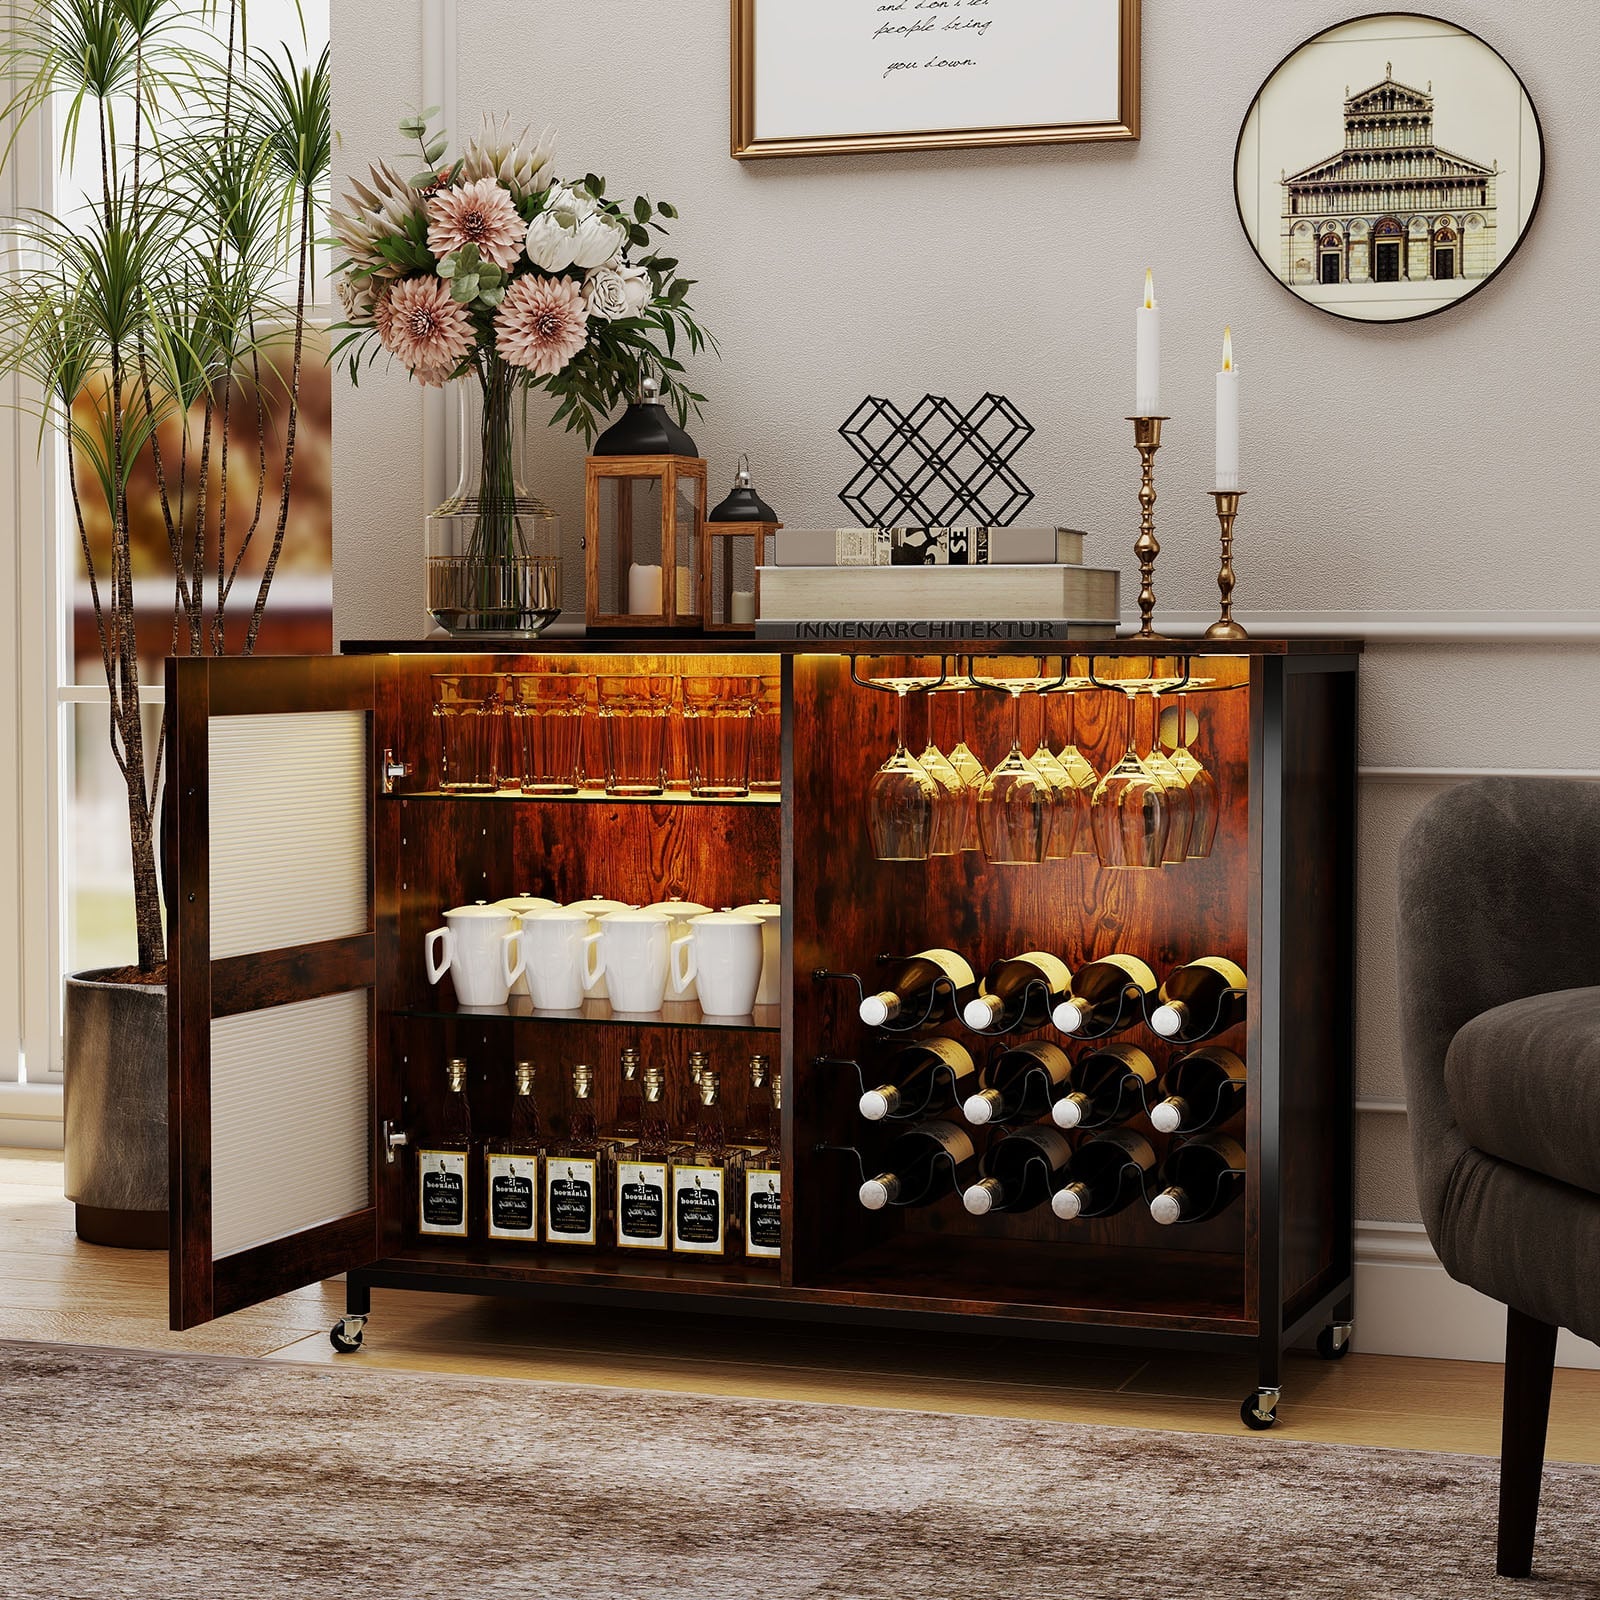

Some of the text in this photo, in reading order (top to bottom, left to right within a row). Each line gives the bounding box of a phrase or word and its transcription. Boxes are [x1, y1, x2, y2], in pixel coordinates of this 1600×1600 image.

[877, 0, 907, 12] and
[872, 15, 993, 40] people bring
[882, 56, 977, 79] you down.
[796, 621, 1054, 638] INNENARCHITEKTUR
